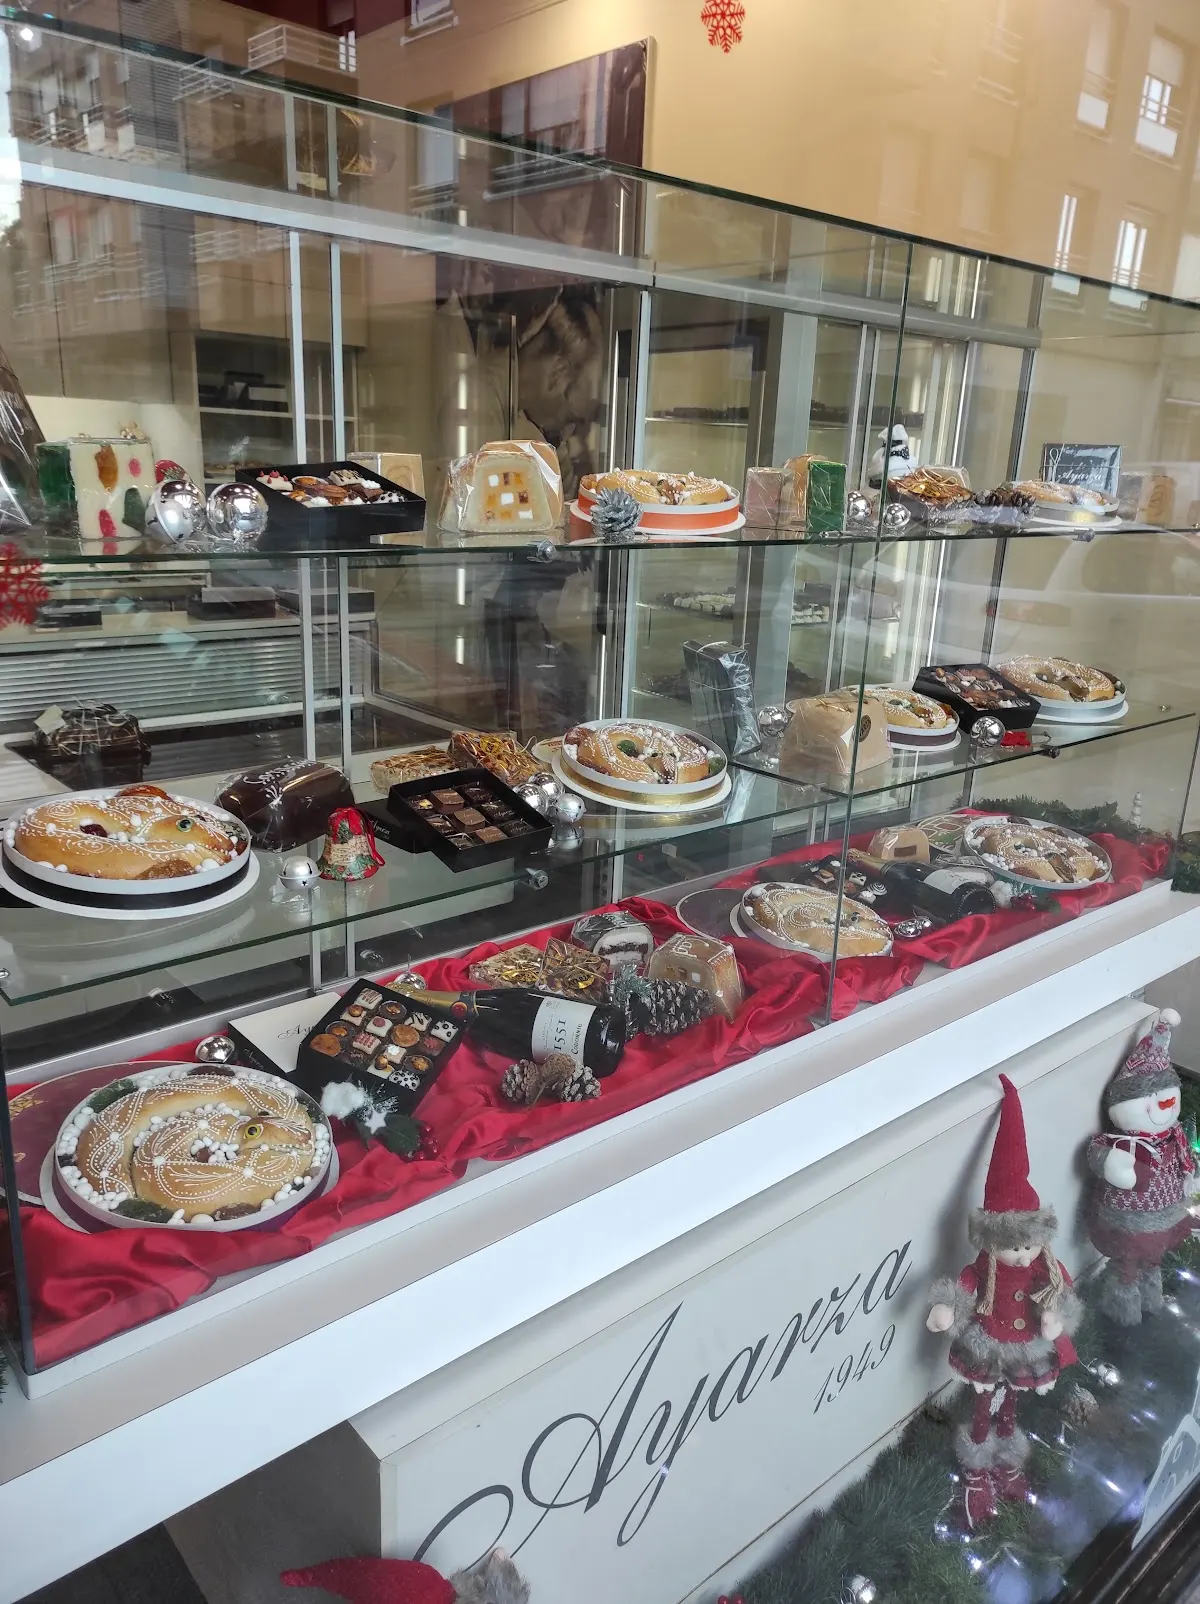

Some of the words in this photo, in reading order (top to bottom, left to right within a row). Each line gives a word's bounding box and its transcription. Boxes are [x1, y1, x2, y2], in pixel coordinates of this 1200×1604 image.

[554, 1019, 567, 1051] 1551
[412, 1239, 913, 1573] Ayarza
[812, 1323, 897, 1415] 1949
